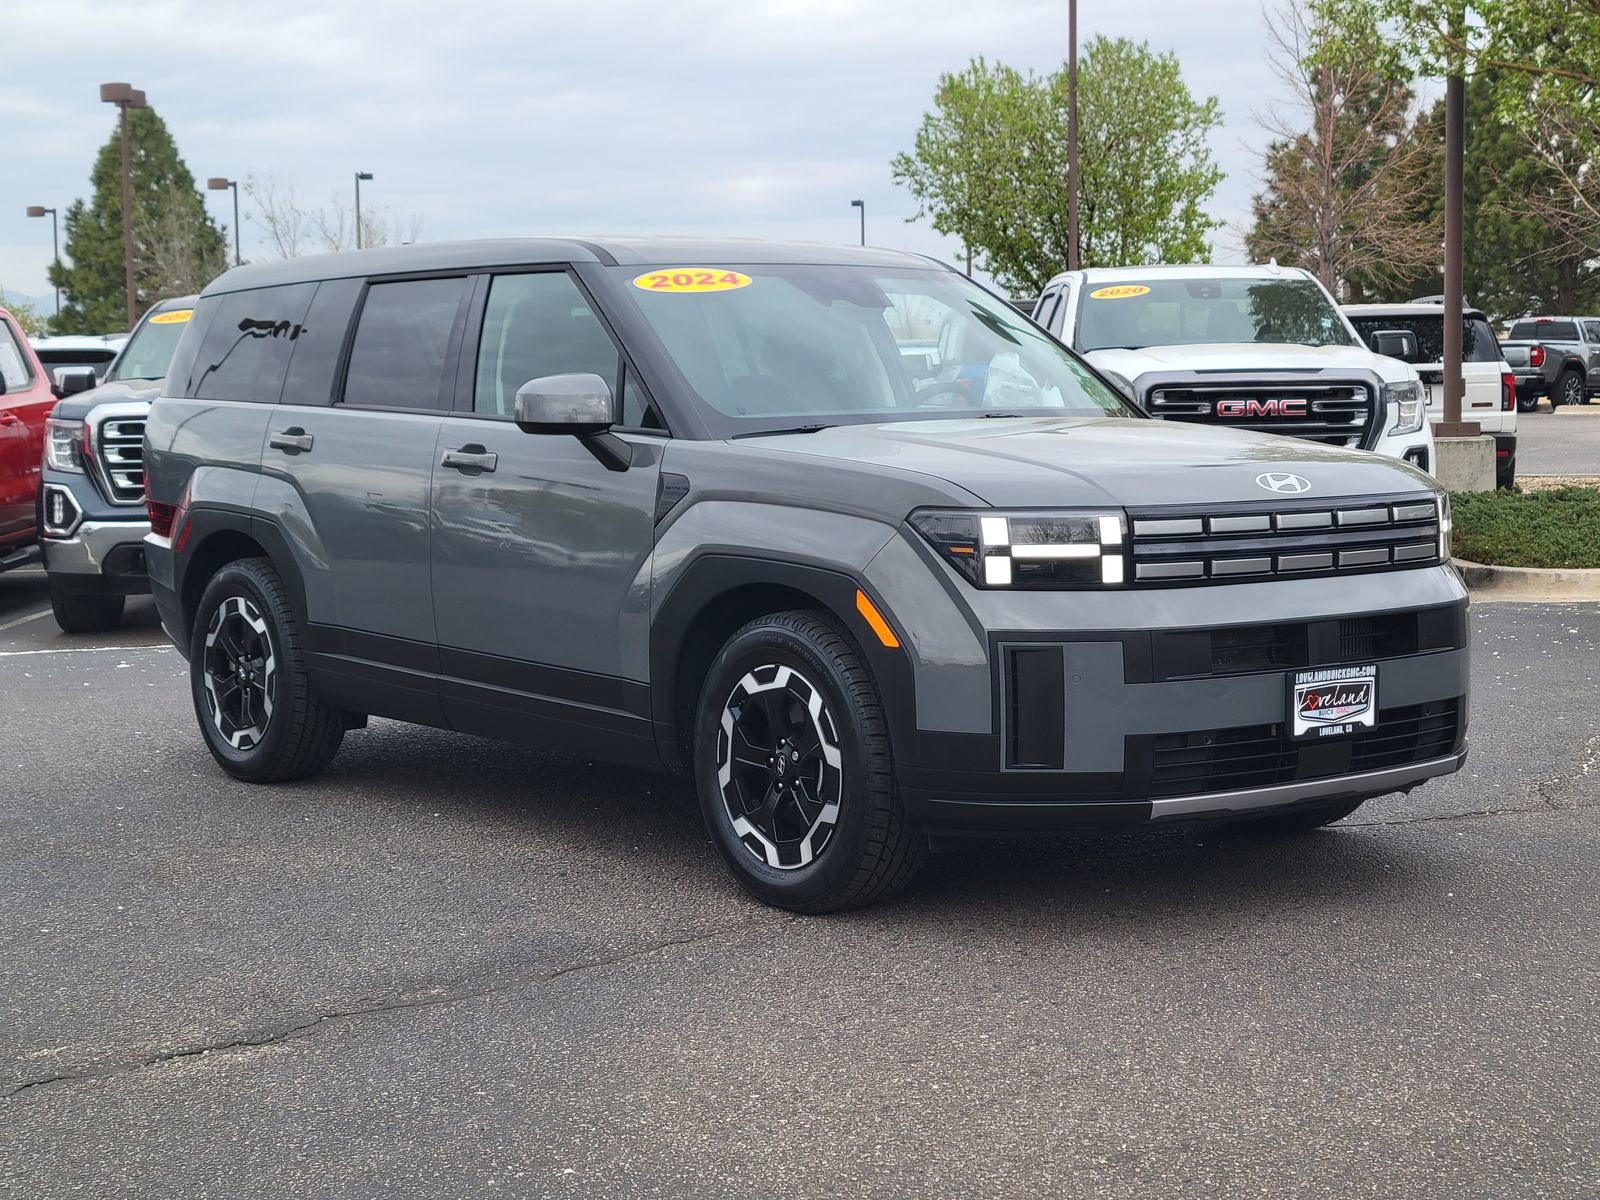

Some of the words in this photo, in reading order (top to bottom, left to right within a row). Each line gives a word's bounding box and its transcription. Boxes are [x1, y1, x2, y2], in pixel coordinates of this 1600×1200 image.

[649, 272, 741, 288] 2024
[1097, 287, 1144, 297] 2020
[1217, 399, 1307, 416] GMC
